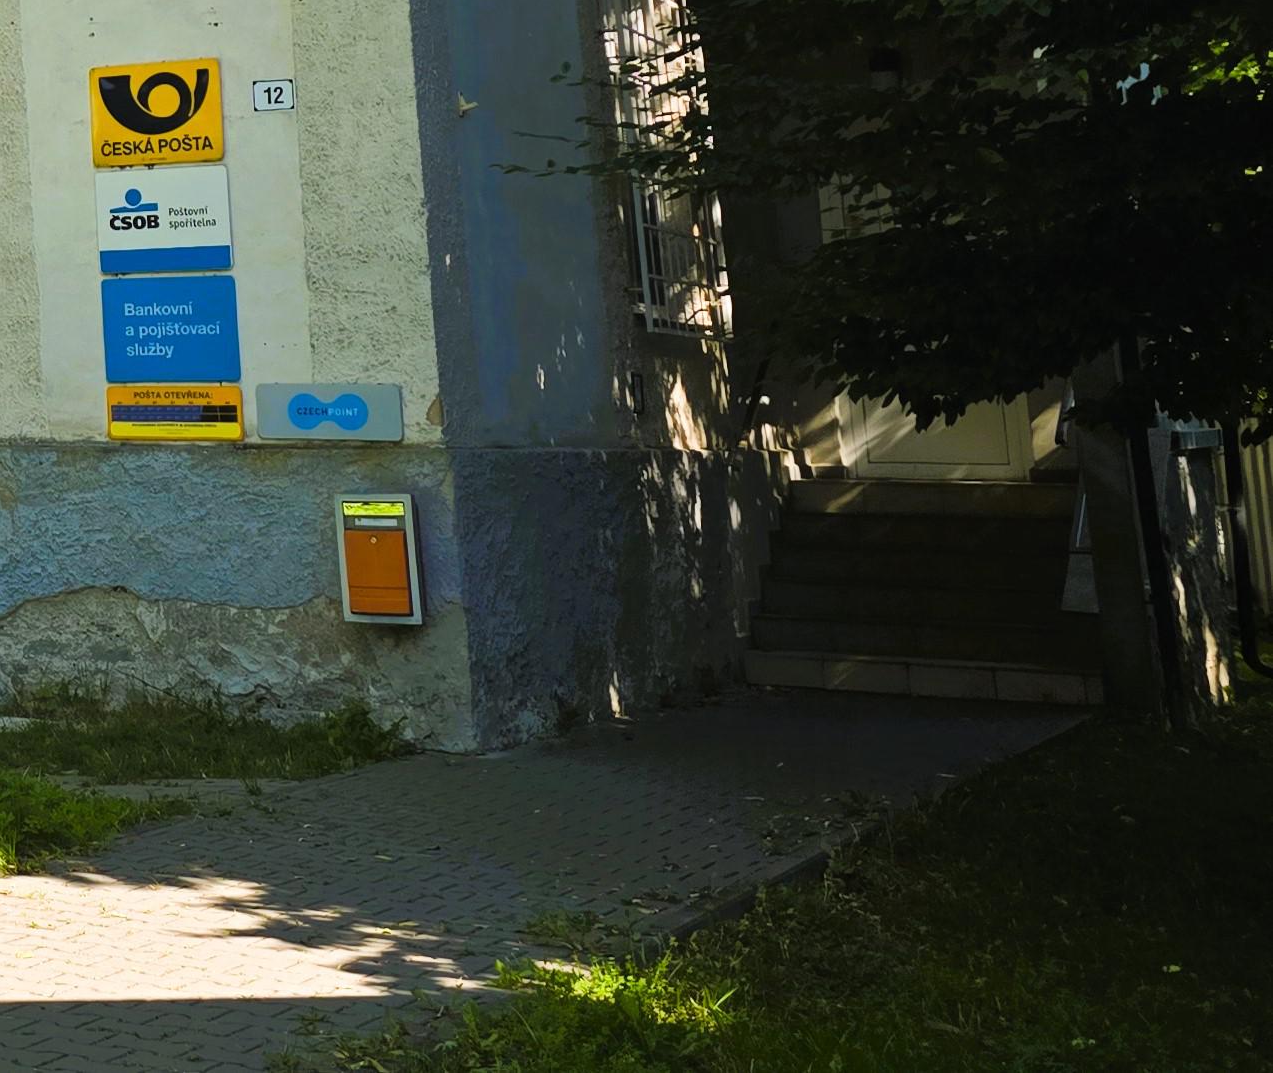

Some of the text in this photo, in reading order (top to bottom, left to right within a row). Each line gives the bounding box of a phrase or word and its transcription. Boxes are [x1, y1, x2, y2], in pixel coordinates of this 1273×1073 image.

[264, 86, 285, 105] 12
[100, 134, 214, 157] ČESKÁ POŠTA
[168, 206, 209, 217] Poštovní
[109, 214, 160, 231] ČSOB
[168, 218, 217, 230] spořitelna
[124, 301, 194, 317] Bankovní
[125, 320, 221, 340] a pojišťovací
[126, 342, 175, 359] služby
[133, 389, 214, 400] POŠTA OTEVŘENA:
